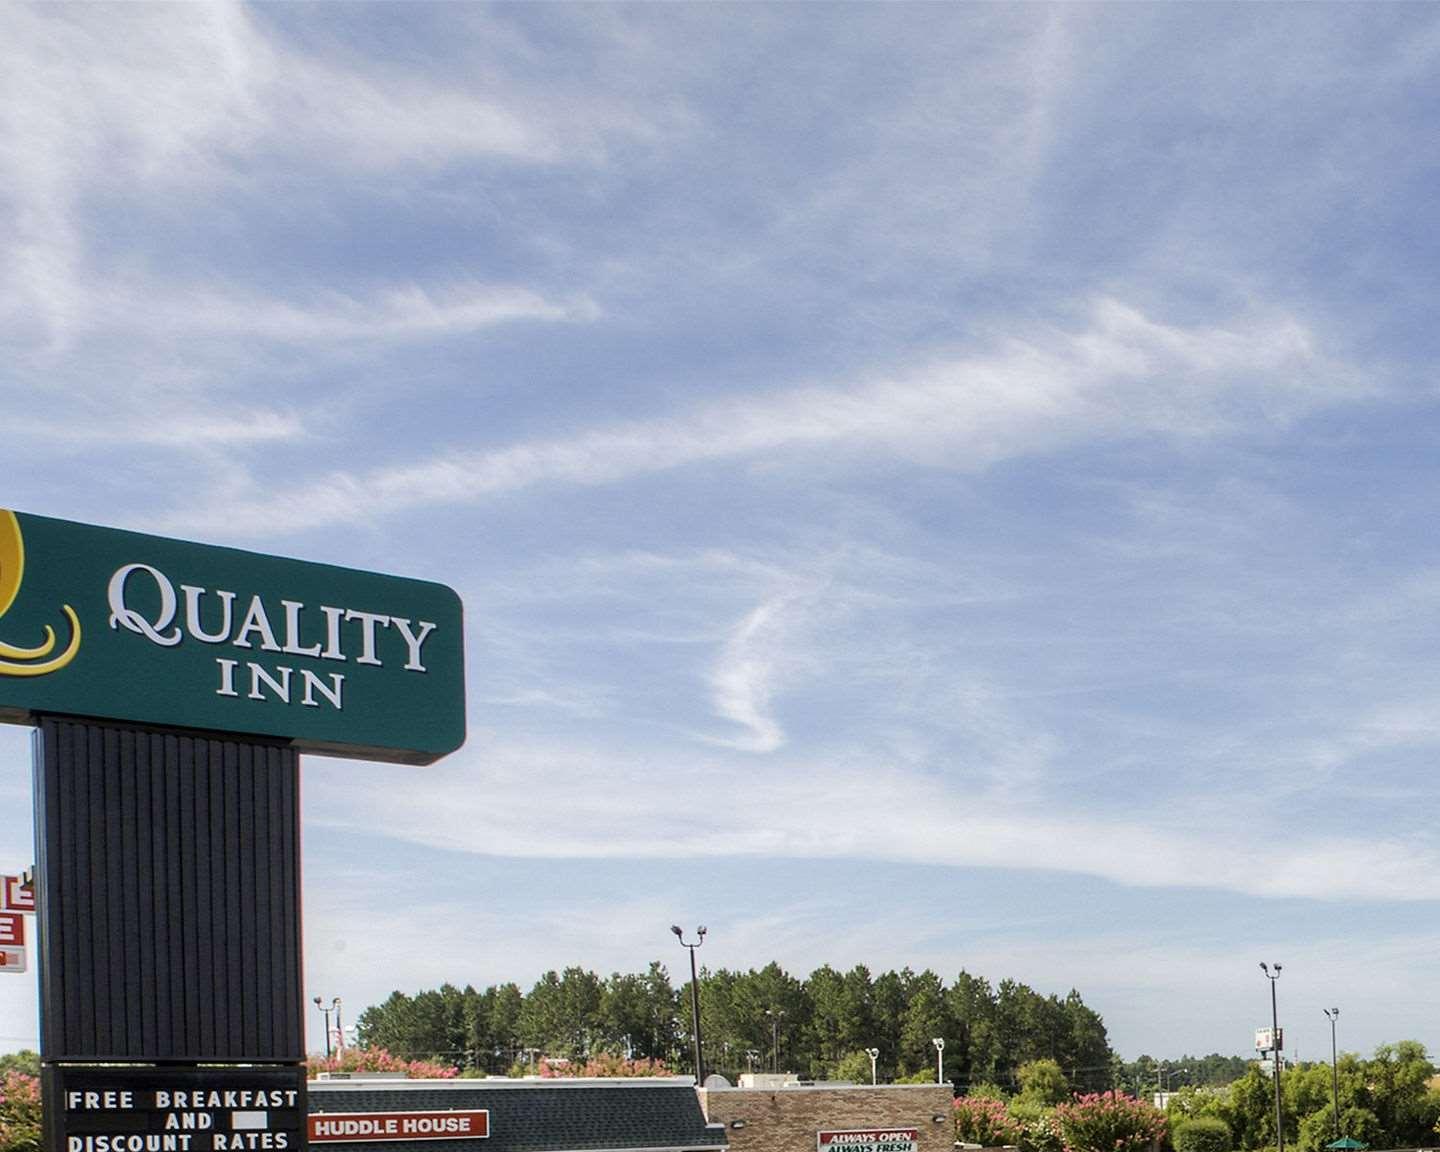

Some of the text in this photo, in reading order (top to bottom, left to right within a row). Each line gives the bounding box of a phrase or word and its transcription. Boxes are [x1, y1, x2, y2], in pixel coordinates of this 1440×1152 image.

[107, 563, 436, 672] QUALITY
[216, 658, 345, 710] INN
[69, 1090, 298, 1109] FREE BREAKFAST
[165, 1112, 212, 1130] AND
[315, 1117, 471, 1136] HUDDLE HOUSE
[68, 1132, 288, 1152] DISCOUNT RATES
[830, 1132, 912, 1143] ALWAYS OPEN
[876, 1143, 912, 1152] FRESH
